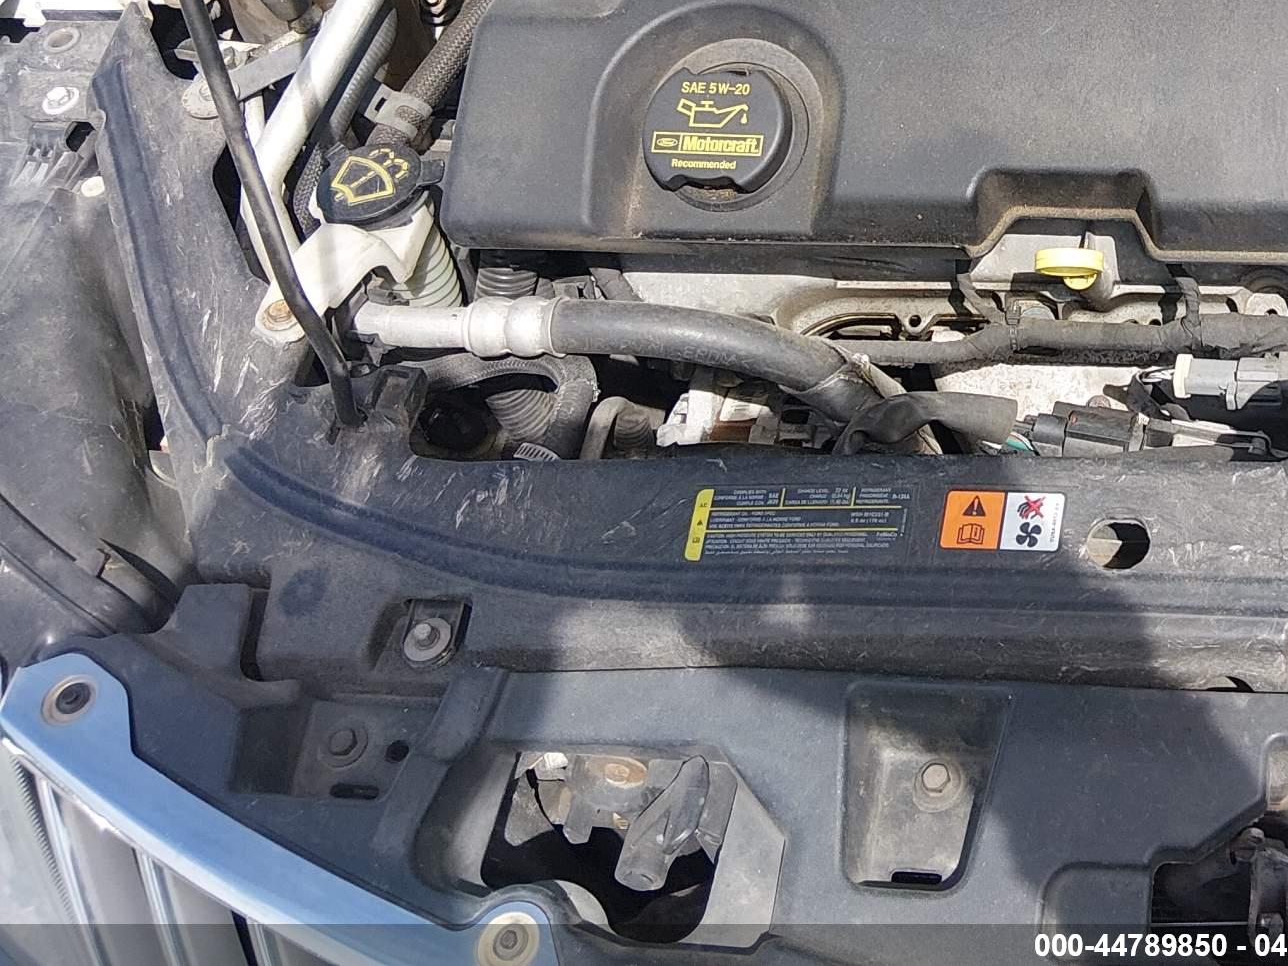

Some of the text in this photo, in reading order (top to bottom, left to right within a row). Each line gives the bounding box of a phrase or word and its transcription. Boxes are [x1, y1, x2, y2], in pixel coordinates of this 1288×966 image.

[681, 81, 751, 96] SAE 5W-20
[683, 136, 759, 153] Motorcraft
[671, 158, 737, 170] Recommended
